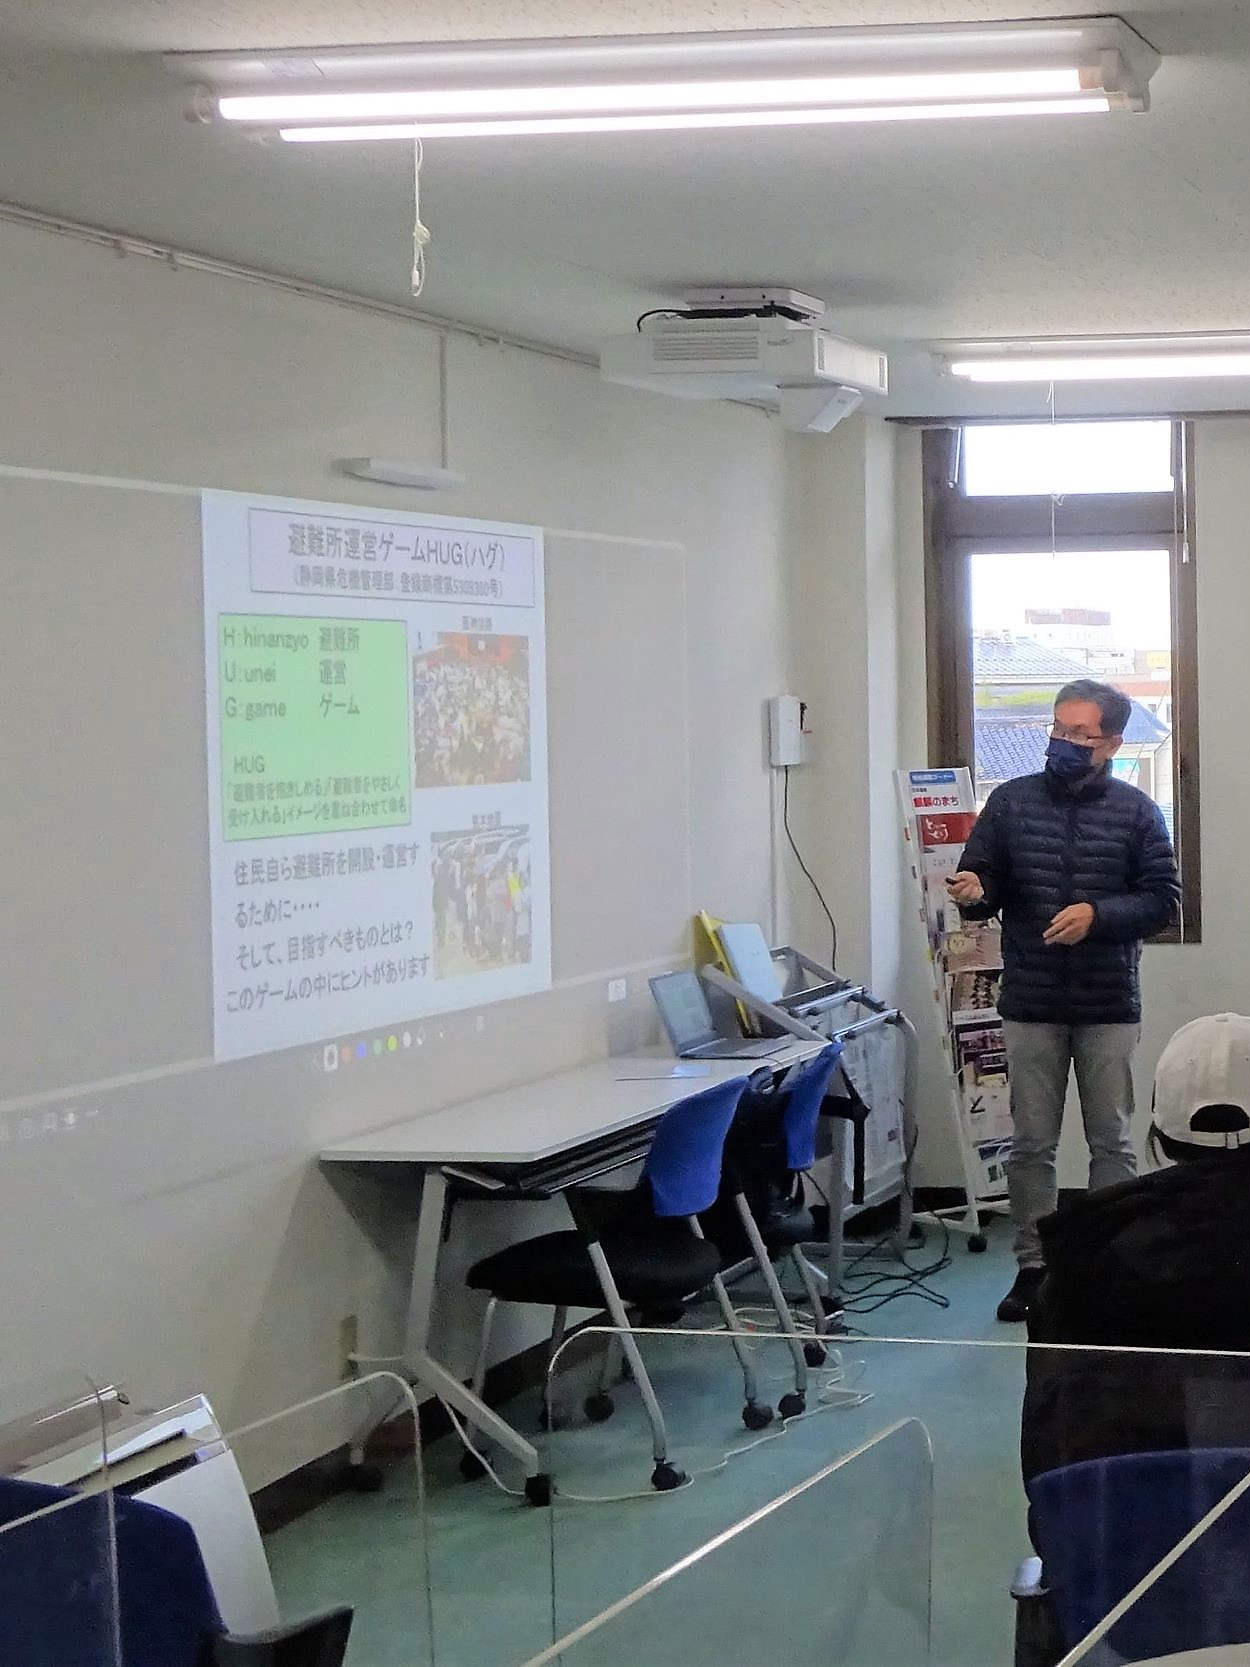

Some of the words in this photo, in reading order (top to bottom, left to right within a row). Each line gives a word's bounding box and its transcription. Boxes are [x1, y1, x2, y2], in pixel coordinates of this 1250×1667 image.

[319, 695, 360, 718] ゲーム
[233, 756, 265, 774] HUG
[226, 954, 431, 1013] このゲームの中にヒントがあります
